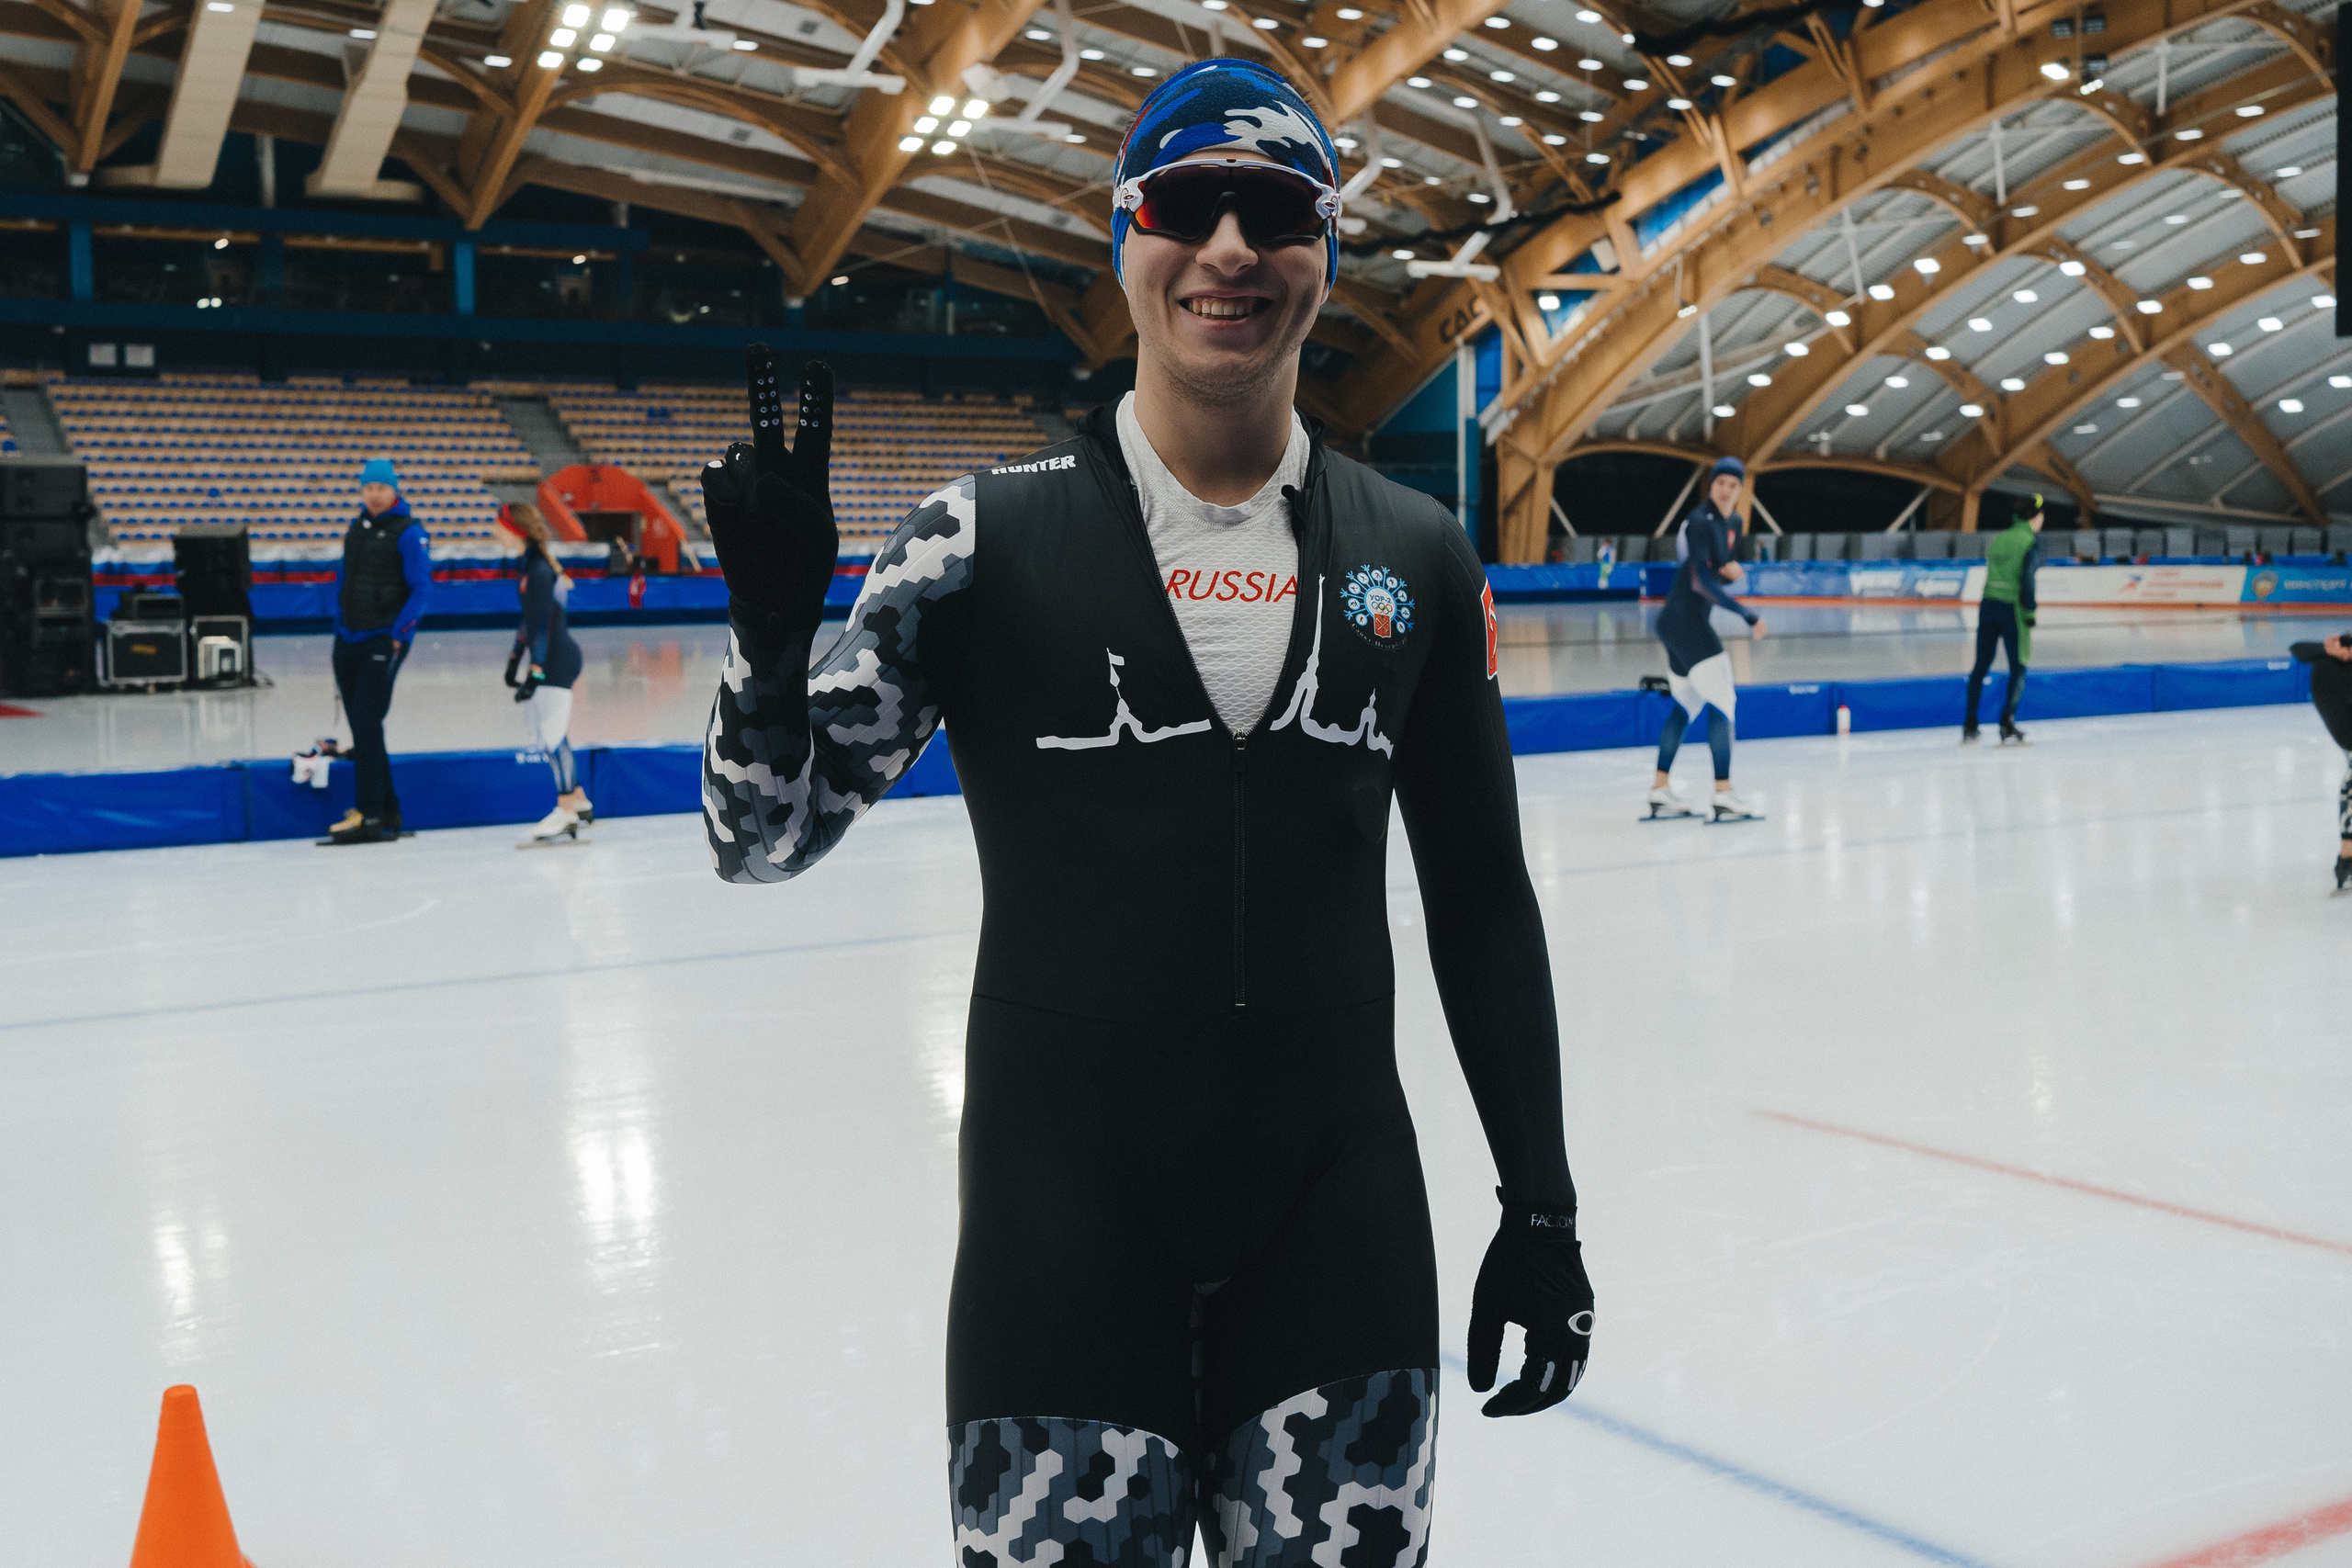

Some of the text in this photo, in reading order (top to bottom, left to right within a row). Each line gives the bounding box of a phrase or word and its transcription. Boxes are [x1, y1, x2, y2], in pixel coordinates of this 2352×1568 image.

[991, 455, 1076, 475] HUNTER
[1165, 569, 1297, 603] RUSSIA
[1369, 593, 1392, 604] УОР-2
